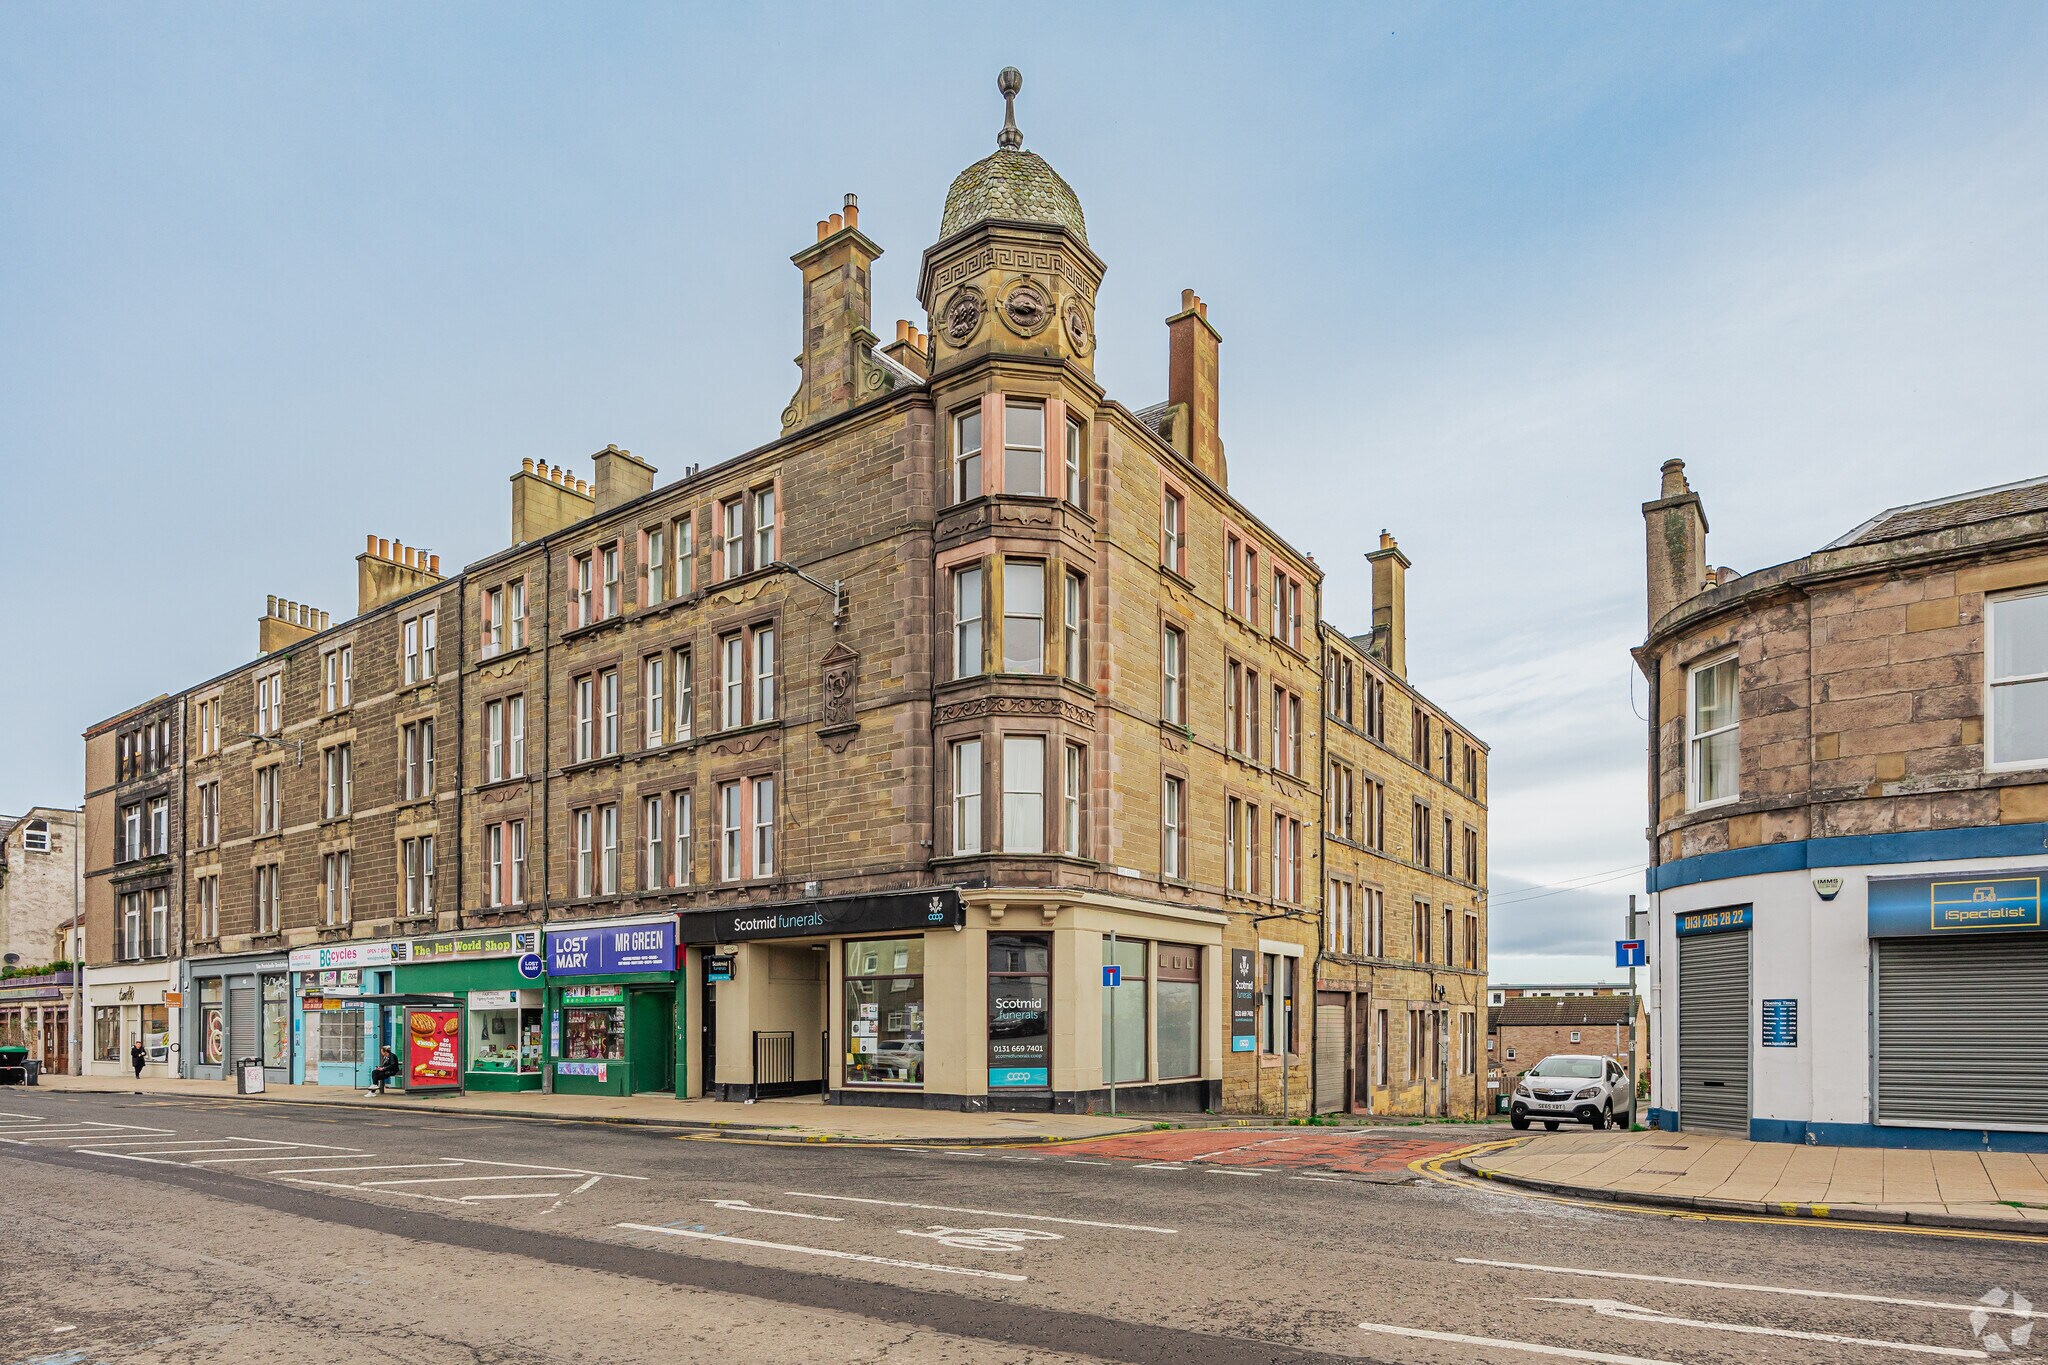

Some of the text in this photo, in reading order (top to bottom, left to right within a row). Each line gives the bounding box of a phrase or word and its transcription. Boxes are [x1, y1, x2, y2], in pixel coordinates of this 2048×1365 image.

[734, 911, 823, 932] Scotmid funerals
[1685, 909, 1744, 929] 0131 285 28 22
[1945, 907, 2025, 922] iSpecialist
[414, 945, 431, 956] The
[435, 942, 453, 955] Just
[454, 940, 482, 951] World
[485, 940, 511, 952] Shop
[556, 936, 588, 953] LOST
[615, 930, 663, 952] MR GREEN
[556, 952, 588, 969] MARY
[1235, 980, 1254, 990] Scotmid
[995, 998, 1042, 1009] Scotmid
[999, 1010, 1039, 1020] funerals
[1007, 1072, 1031, 1083] coop
